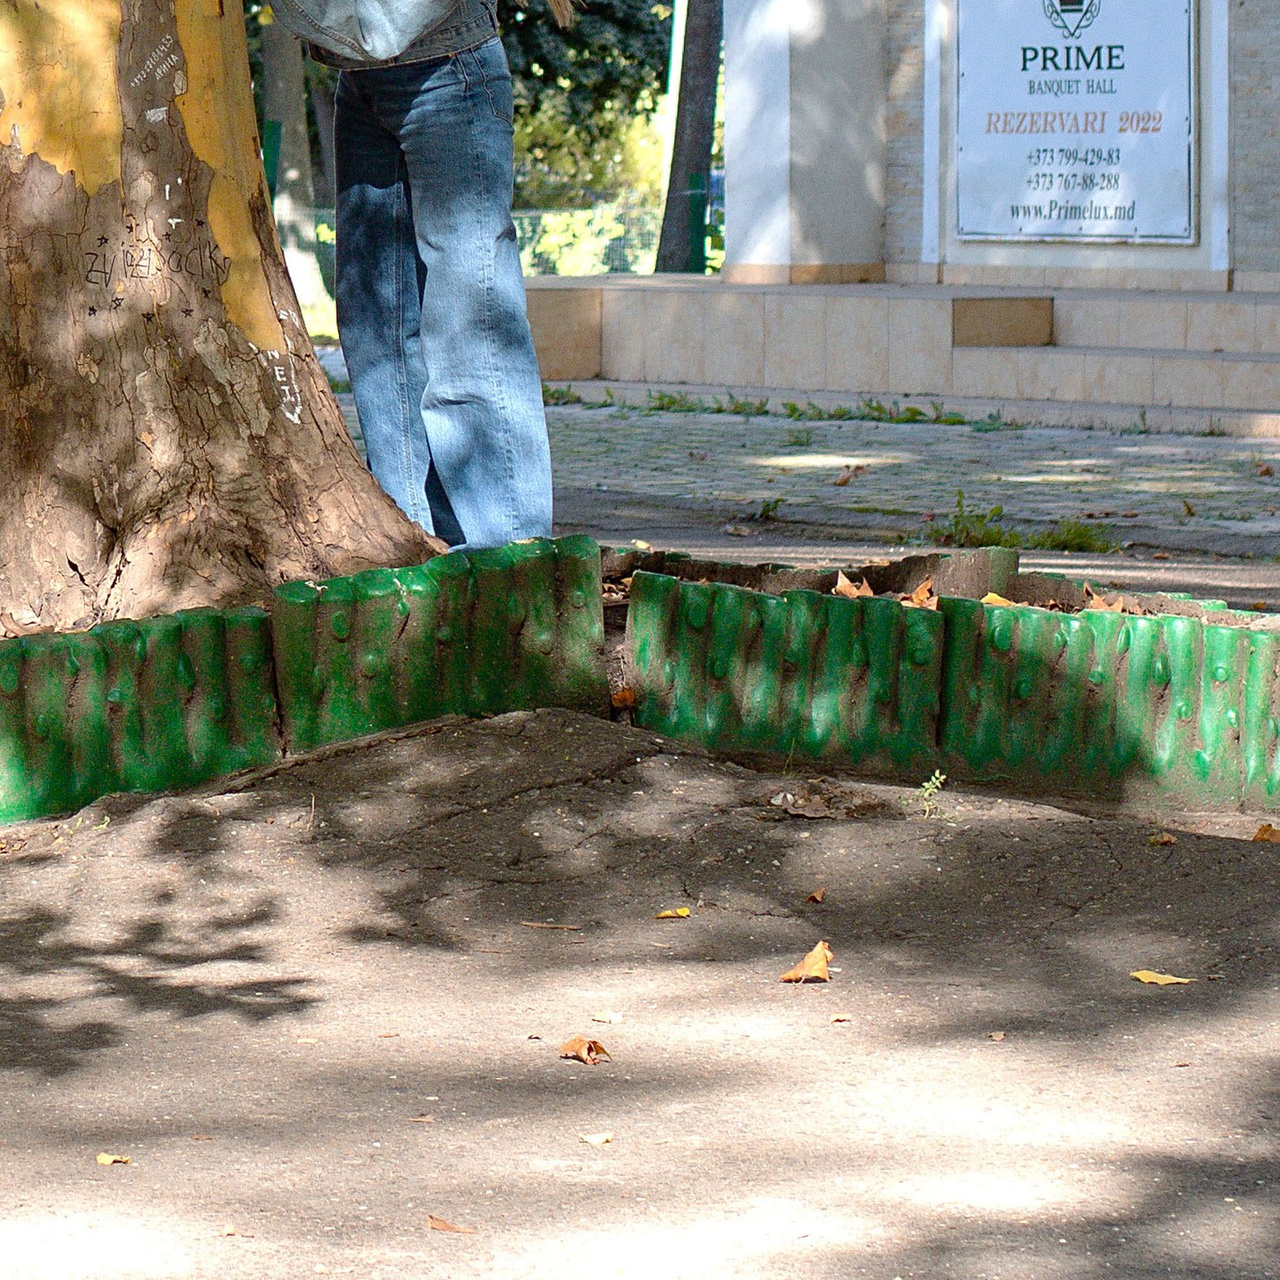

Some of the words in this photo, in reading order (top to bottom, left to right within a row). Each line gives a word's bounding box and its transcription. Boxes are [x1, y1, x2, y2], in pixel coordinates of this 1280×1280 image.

[1021, 44, 1125, 72] PRIME
[1028, 79, 1081, 97] BANQUET
[1086, 79, 1117, 94] HALL
[985, 110, 1108, 135] REZERVARI
[1118, 110, 1163, 134] 2022
[1027, 148, 1055, 166] +373
[1058, 148, 1121, 166] 799-429-83
[1026, 173, 1054, 191] +373
[1057, 173, 1120, 191] 767-88-288
[1010, 199, 1136, 221] www.Primelux.md
